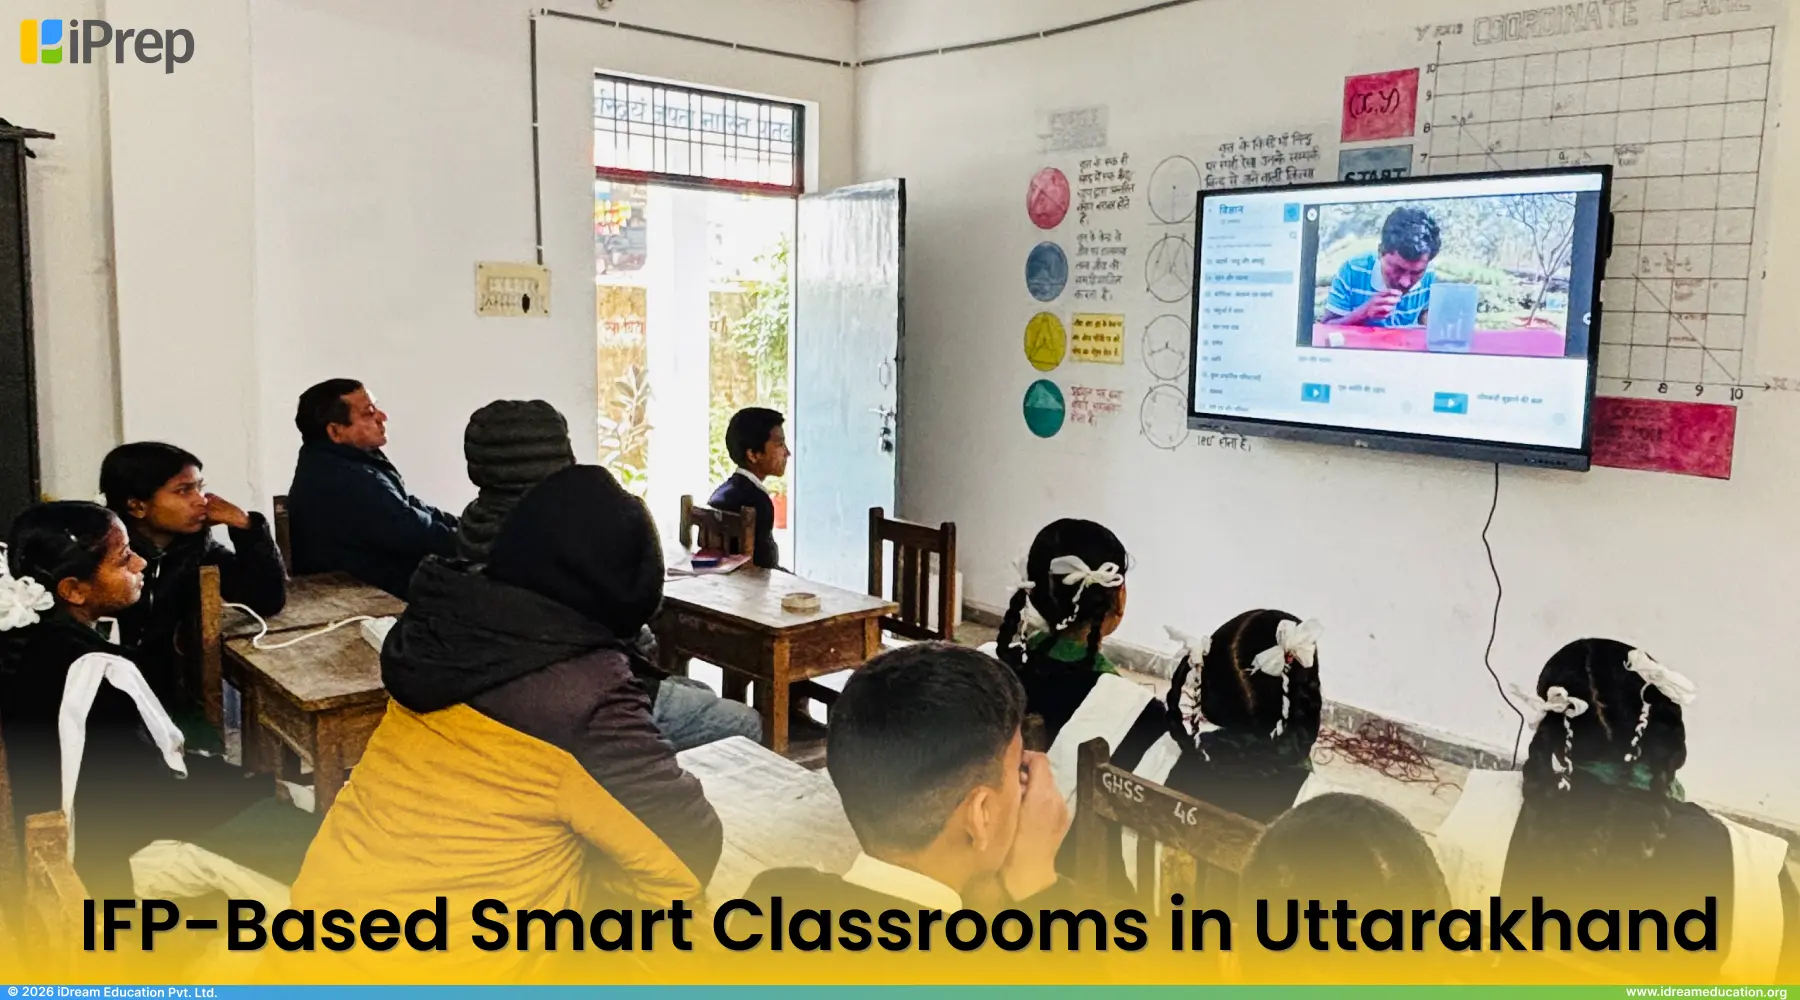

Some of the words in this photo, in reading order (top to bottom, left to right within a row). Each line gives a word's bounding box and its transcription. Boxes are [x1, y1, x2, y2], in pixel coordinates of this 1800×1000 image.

[1473, 0, 1638, 46] COORDINATE
[1423, 123, 1431, 134] 8
[1219, 204, 1244, 215] विज्ञान
[1622, 381, 1632, 391] 7
[1658, 382, 1668, 394] 8
[1695, 384, 1704, 397] 9
[1729, 388, 1744, 401] 10
[1102, 772, 1145, 803] GHSS
[1173, 801, 1198, 826] 46
